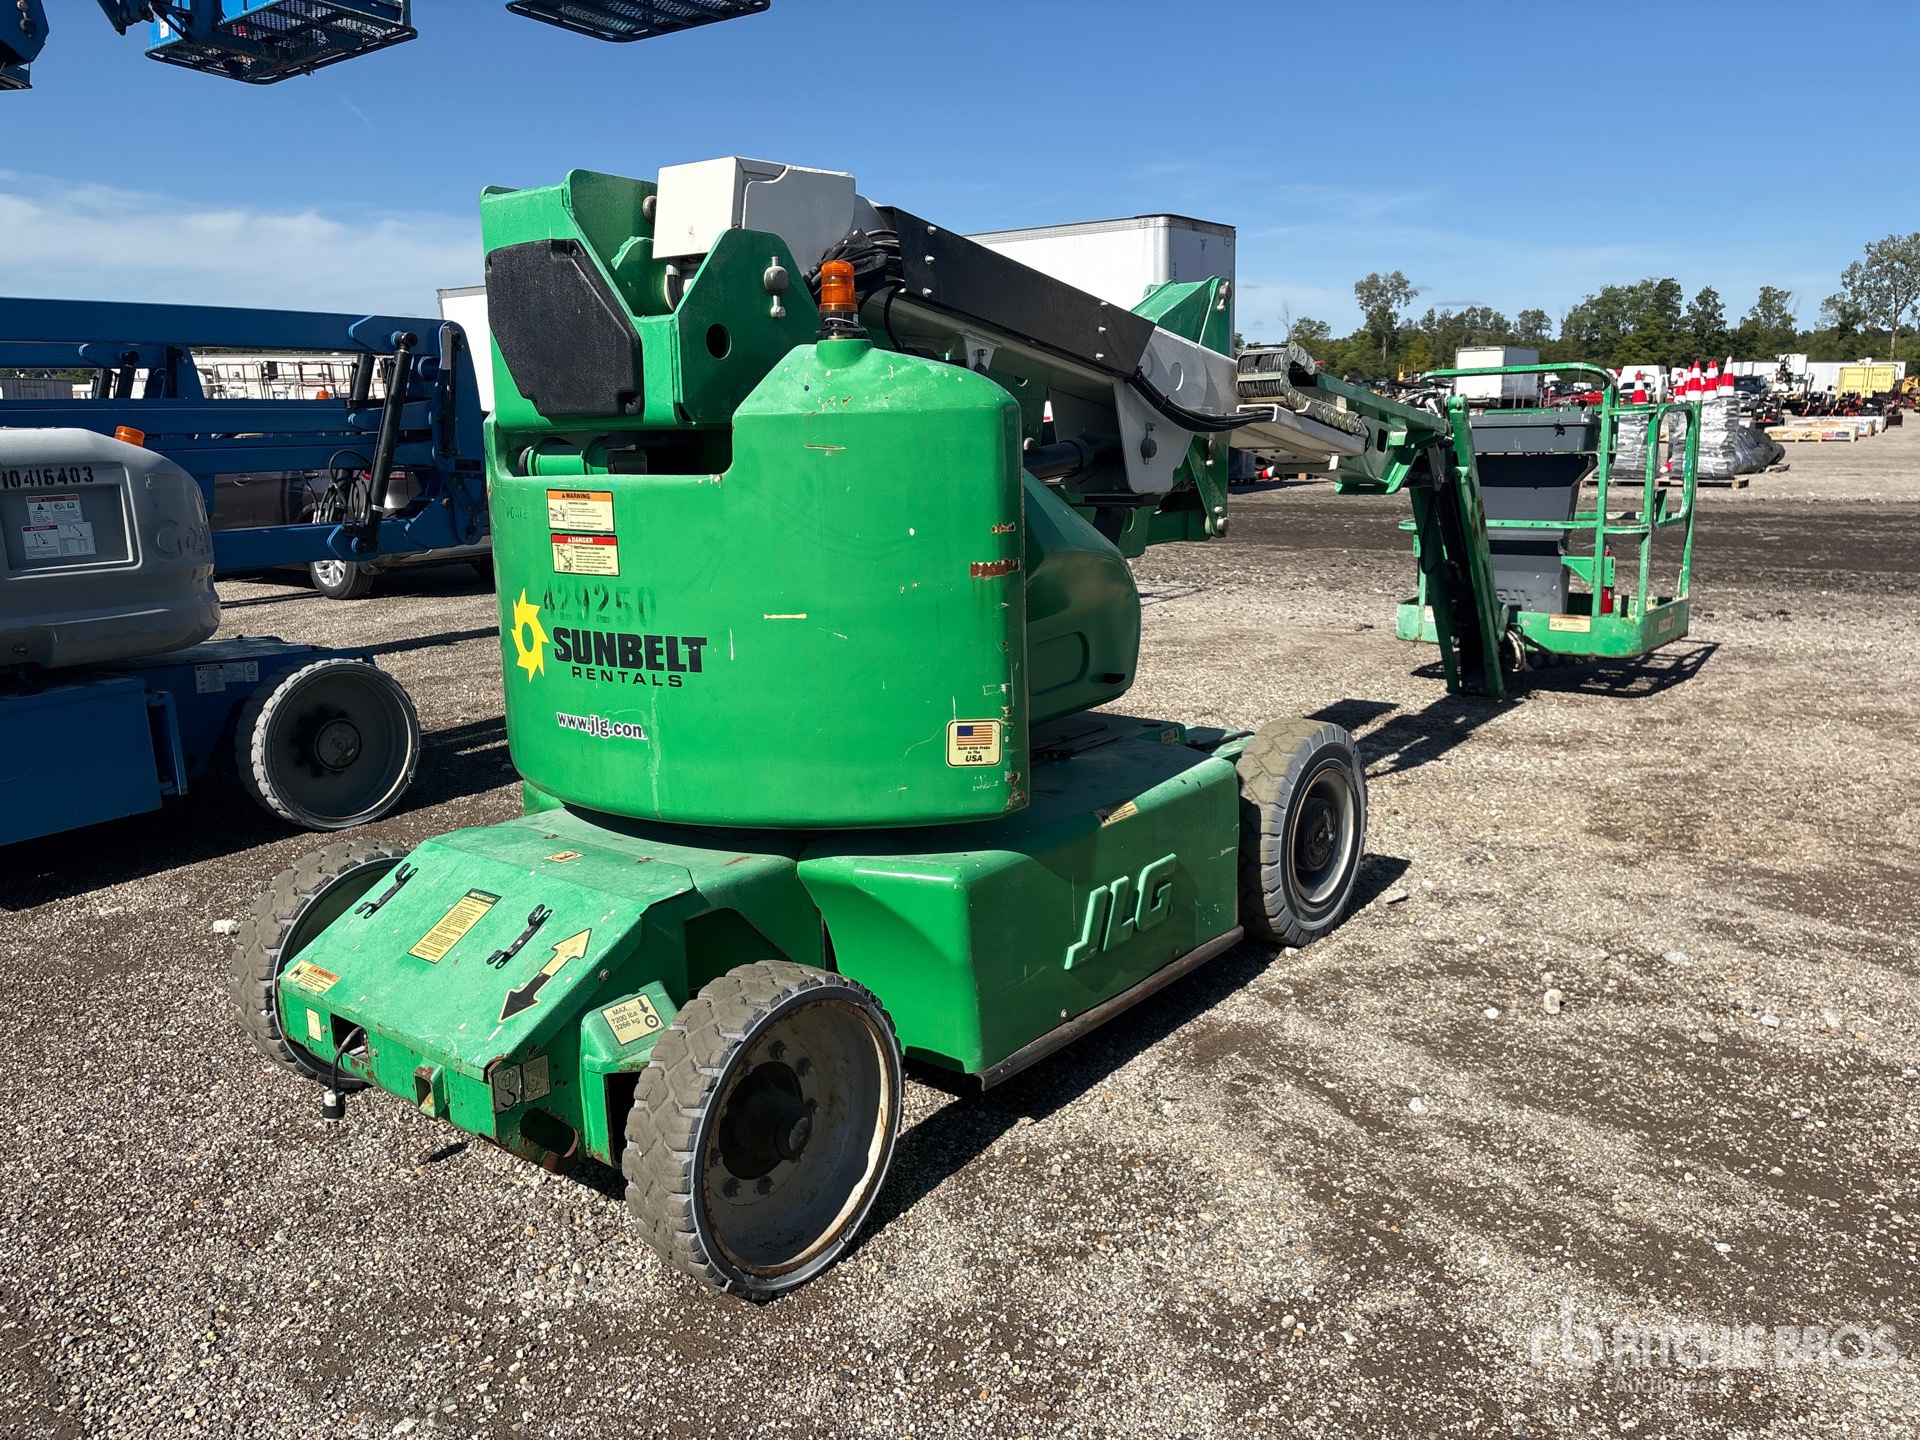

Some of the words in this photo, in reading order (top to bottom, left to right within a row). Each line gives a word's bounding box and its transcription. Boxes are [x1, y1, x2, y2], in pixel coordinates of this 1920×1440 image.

[2, 465, 94, 489] 10416403
[566, 492, 590, 500] WARNING
[553, 627, 708, 674] SUNBELT
[572, 665, 683, 688] RENTALS
[1063, 853, 1177, 971] JLG
[611, 1015, 628, 1025] 7200
[627, 1011, 638, 1019] lbs
[612, 1006, 629, 1016] MAX
[614, 1020, 632, 1031] 3266
